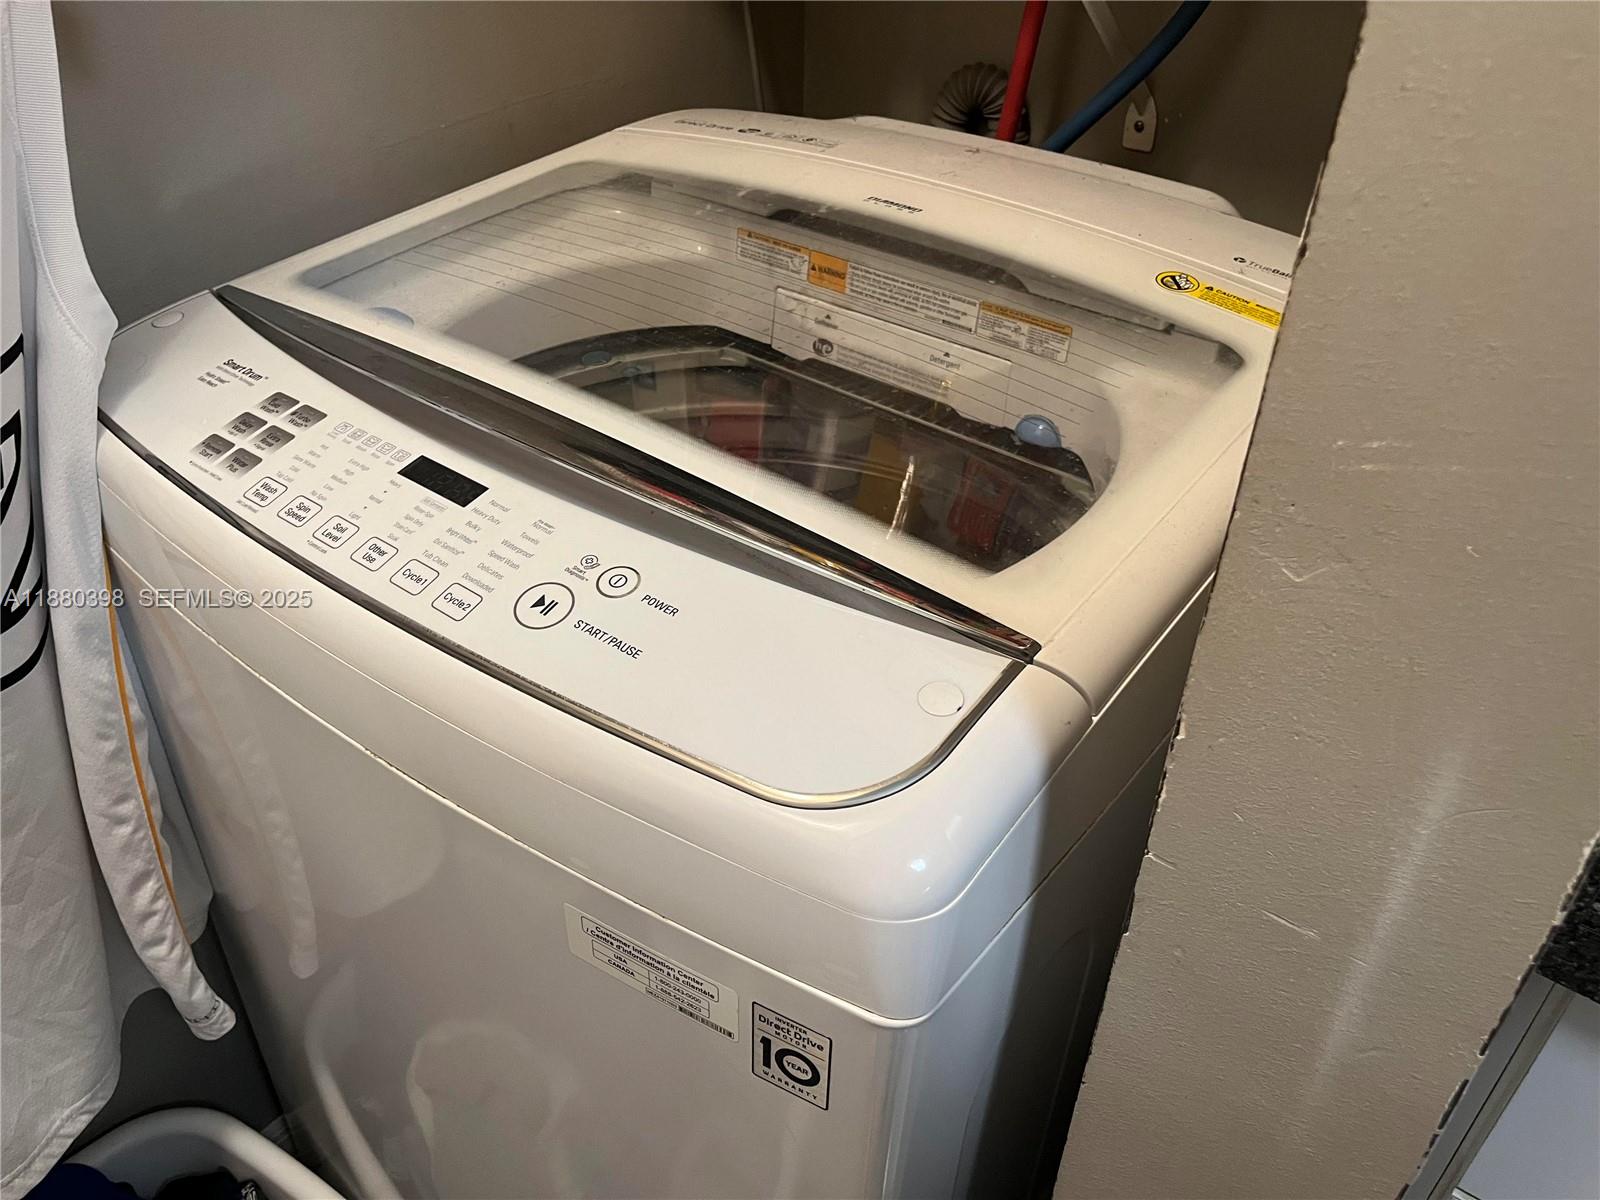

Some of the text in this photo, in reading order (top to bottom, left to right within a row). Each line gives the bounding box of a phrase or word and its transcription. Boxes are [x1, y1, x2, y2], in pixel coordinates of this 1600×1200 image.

[817, 265, 845, 280] WARNING
[1216, 288, 1250, 304] CAUTION
[930, 353, 960, 370] Detergent
[223, 359, 247, 373] Smart
[242, 368, 264, 382] Drum
[232, 424, 246, 434] Wash
[199, 449, 213, 459] Start
[252, 489, 269, 502] Temp
[260, 482, 278, 495] Wash
[296, 502, 311, 514] Spin
[489, 499, 512, 512] Normal
[285, 507, 307, 522] Speed
[471, 507, 502, 525] Heavy Duty
[333, 523, 349, 534] Soil
[465, 520, 482, 532] Bulky
[532, 521, 554, 536] Normal
[321, 528, 342, 543] Level
[519, 531, 540, 545] Towels
[368, 543, 388, 558] Other
[500, 539, 535, 559] Waterproof
[362, 552, 377, 564] Use
[422, 549, 449, 568] Tub Clean
[487, 550, 520, 570] Speed Wash
[477, 562, 505, 581] Delicates
[572, 565, 587, 575] Smart
[461, 571, 496, 594] Downloaded
[640, 594, 680, 618] POWER
[573, 619, 643, 660] START/PAUSE
[590, 929, 615, 947] Centre
[595, 926, 705, 987] Customer Information Center
[613, 954, 628, 965] USA
[607, 959, 636, 977] CANADA
[758, 1013, 824, 1052] Direct Drive
[774, 1017, 808, 1035] INVERTER
[774, 1030, 807, 1049] MOTOR
[760, 1035, 821, 1087] 10
[785, 1060, 809, 1077] YEAR
[762, 1069, 818, 1100] WARRANTY
